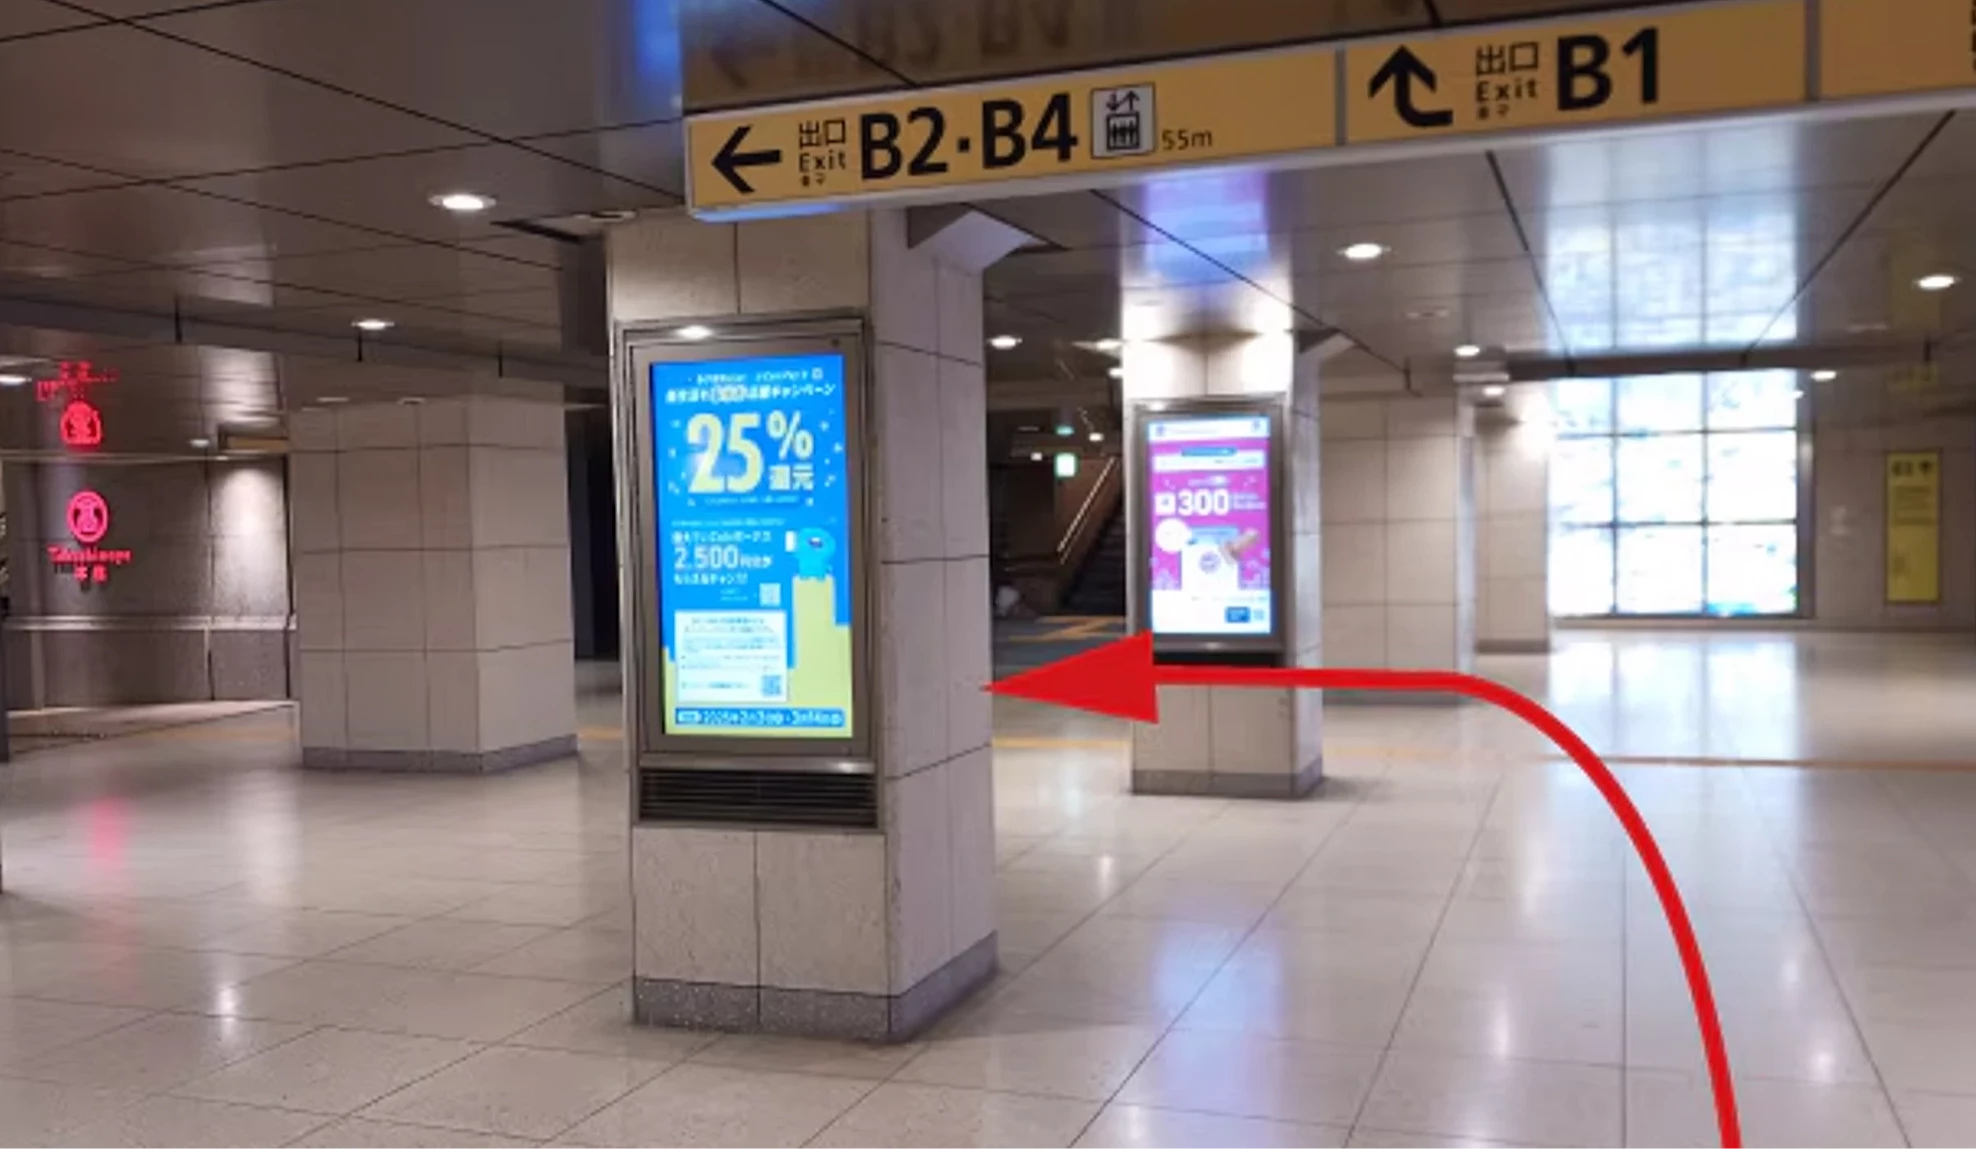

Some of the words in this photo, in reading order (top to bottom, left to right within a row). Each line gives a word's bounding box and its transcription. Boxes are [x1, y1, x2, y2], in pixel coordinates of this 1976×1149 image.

[1476, 41, 1539, 75] 出口
[1557, 27, 1657, 111] B1
[1476, 78, 1538, 103] Exit
[799, 117, 846, 149] 出口
[1161, 129, 1213, 150] 55m
[799, 150, 846, 172] Exit
[1178, 488, 1229, 516] 300
